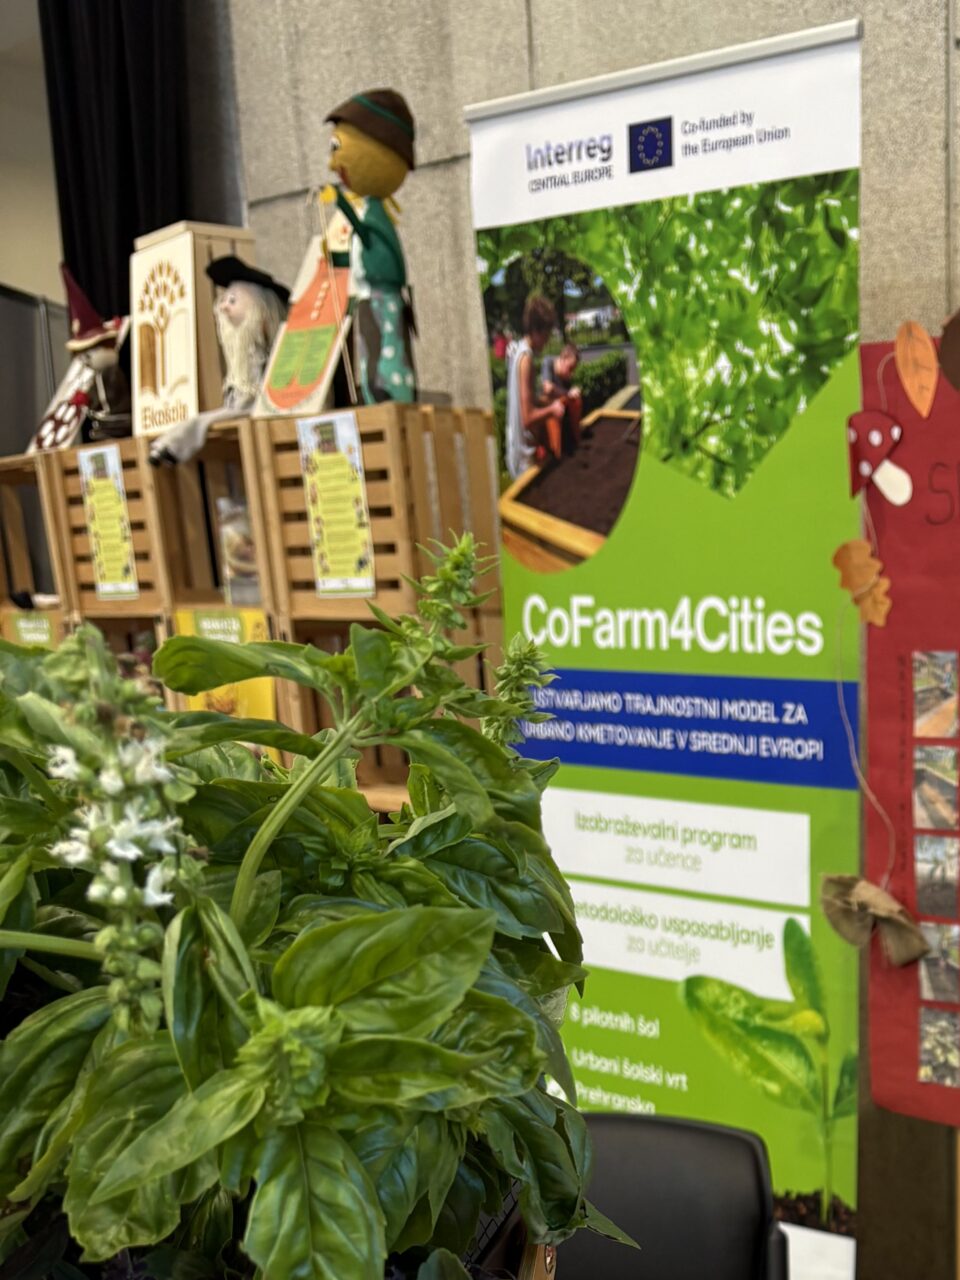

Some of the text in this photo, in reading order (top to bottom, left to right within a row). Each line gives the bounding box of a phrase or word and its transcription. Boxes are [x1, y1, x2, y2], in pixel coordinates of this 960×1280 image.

[681, 111, 754, 135] Co-funded by
[526, 134, 613, 171] Interreg
[682, 126, 791, 157] the European Union
[529, 165, 613, 193] CENTRAL EUROPE
[522, 594, 824, 655] CoFarm4Cities
[624, 692, 721, 721] TRAJNOSTNI
[723, 700, 778, 725] MODEL
[782, 703, 808, 725] ZA
[576, 722, 674, 750] KMETOVANJE
[675, 730, 687, 750] V
[689, 732, 757, 757] SREDNJI
[760, 737, 823, 761] EVROPI
[575, 811, 757, 853] Izobraževalni program
[625, 847, 644, 864] za
[575, 900, 775, 951] etodološko usposabljanje
[627, 936, 645, 953] za
[572, 1047, 688, 1091] Urbani šolski vrt
